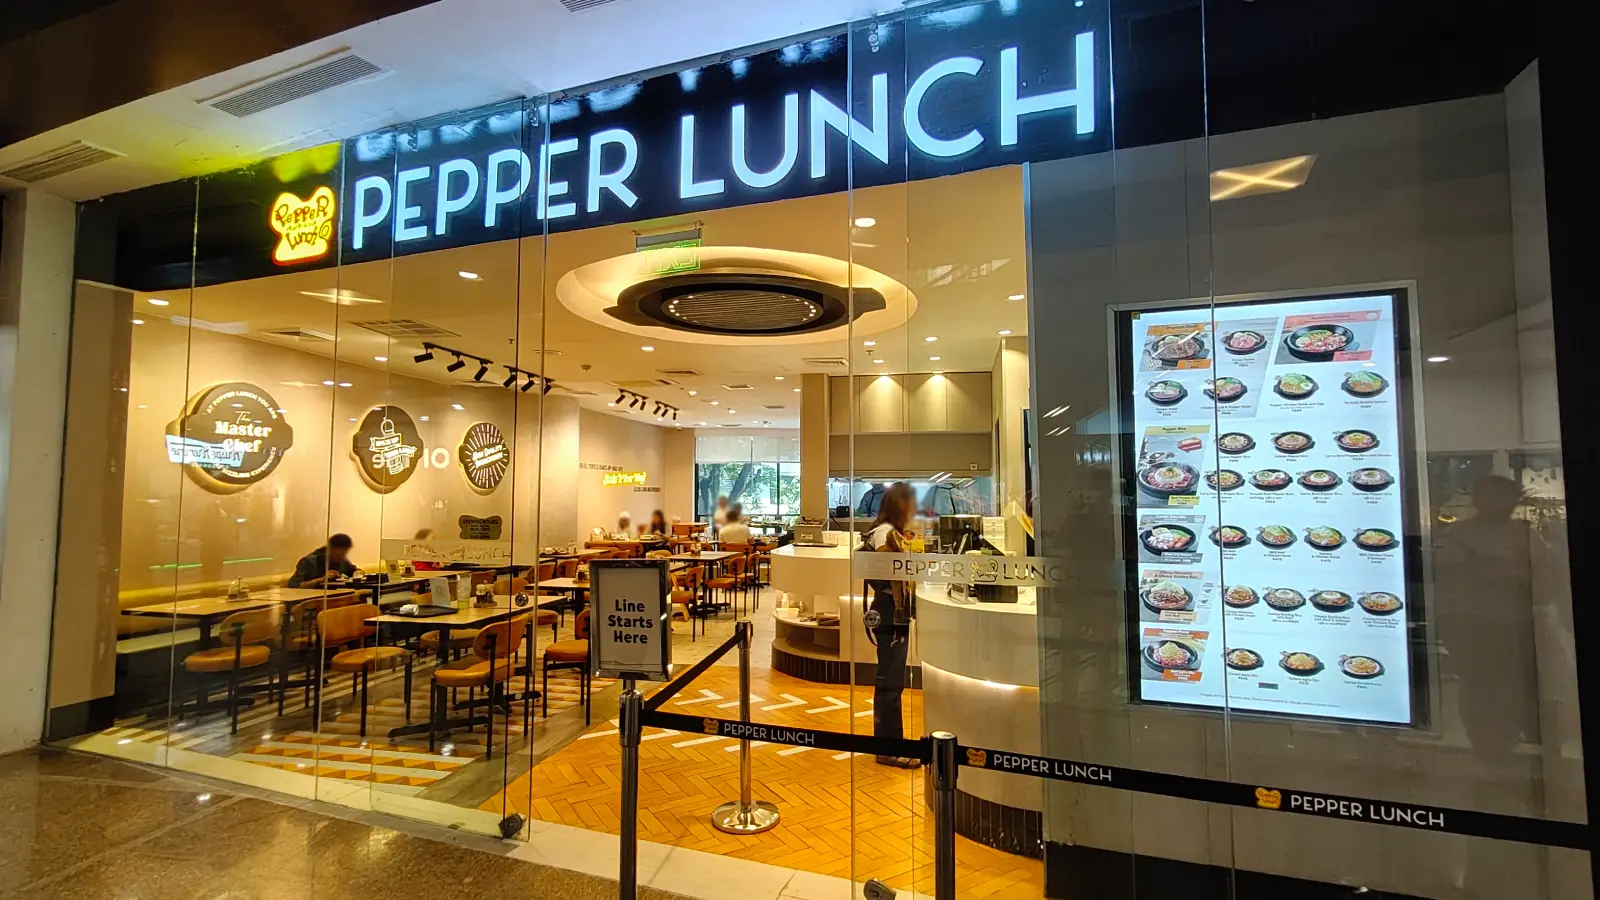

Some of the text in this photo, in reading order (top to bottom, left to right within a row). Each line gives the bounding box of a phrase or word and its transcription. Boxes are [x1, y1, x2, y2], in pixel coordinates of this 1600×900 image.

[353, 32, 1095, 250] PEPPER LUNCH
[215, 421, 272, 437] Master
[223, 437, 262, 453] Chef
[892, 559, 965, 578] PEPPER
[615, 599, 645, 613] Line
[607, 614, 654, 629] Starts
[613, 630, 648, 644] Here
[724, 723, 815, 745] PEPPER LUNCH
[993, 754, 1112, 782] PEPPER LUNCH
[1290, 794, 1445, 828] PEPPER LUNCH
